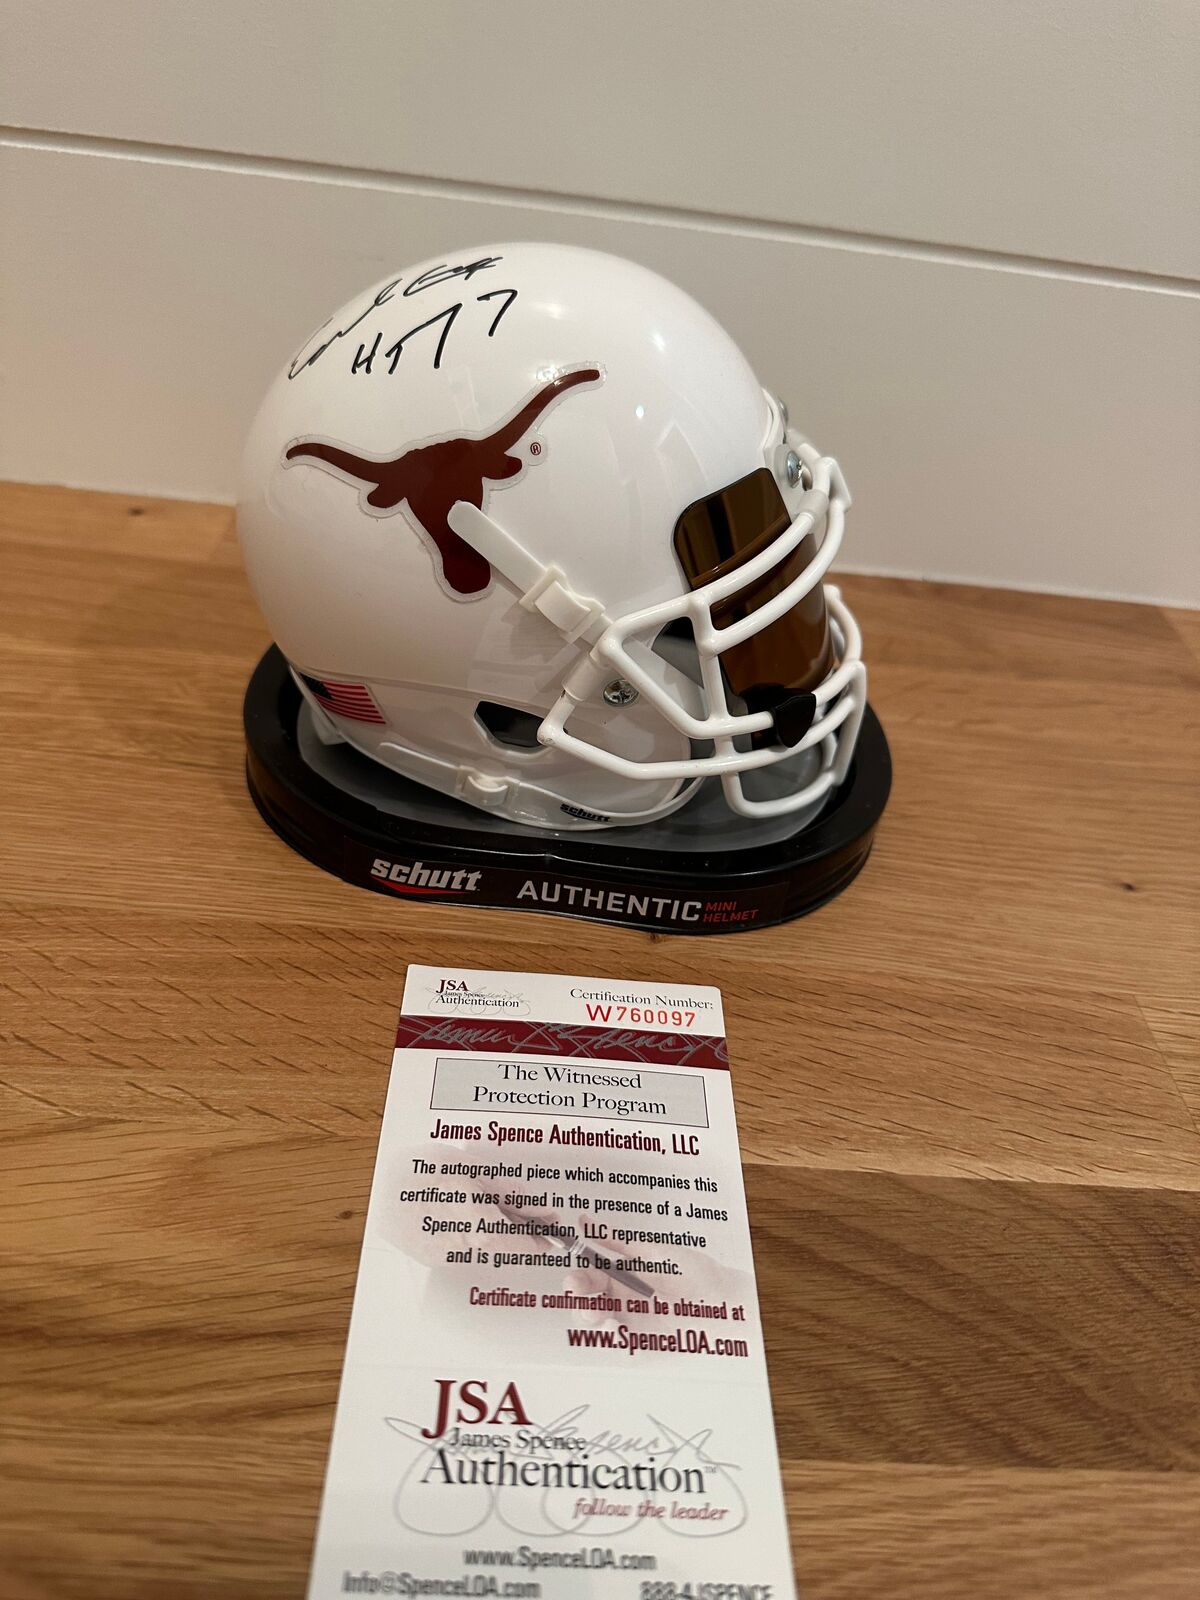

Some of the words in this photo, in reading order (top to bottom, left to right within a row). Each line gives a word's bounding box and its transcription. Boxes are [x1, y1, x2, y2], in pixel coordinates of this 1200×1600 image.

[561, 803, 610, 822] schutt
[370, 858, 482, 891] schutt
[517, 880, 702, 922] AUTHENTIC
[705, 901, 737, 912] MINI
[703, 909, 759, 922] HELMET
[436, 979, 469, 993] JSA
[570, 987, 651, 1006] Certification
[655, 996, 713, 1010] Number:
[436, 994, 519, 1008] Authentication
[586, 1003, 696, 1027] W760097
[498, 1064, 538, 1081] The
[544, 1066, 642, 1089] Witnessed
[473, 1086, 575, 1107] Protection
[582, 1092, 667, 1116] Program
[430, 1119, 481, 1141] James
[487, 1121, 543, 1146] Spence
[549, 1124, 666, 1155] Authentication,
[672, 1133, 700, 1156] LLC
[412, 1159, 436, 1175] The
[441, 1162, 523, 1182] autographed
[527, 1164, 560, 1182] piece
[565, 1166, 604, 1183] which
[608, 1171, 690, 1194] accompanies
[694, 1177, 718, 1193] this
[400, 1188, 467, 1205] certificate
[471, 1193, 500, 1207] was
[504, 1191, 547, 1213] signed
[552, 1194, 564, 1209] in
[569, 1195, 590, 1211] the
[594, 1199, 652, 1217] presence
[656, 1202, 670, 1216] of
[674, 1206, 682, 1217] a
[686, 1203, 728, 1223] James
[421, 1217, 471, 1237] Spence
[476, 1219, 579, 1241] Authentication,
[584, 1224, 608, 1241] LLC
[612, 1229, 707, 1249] representative
[446, 1248, 472, 1264] and
[477, 1248, 489, 1264] is
[494, 1252, 571, 1270] guaranteed
[576, 1253, 590, 1269] to
[595, 1254, 612, 1271] be
[616, 1258, 683, 1276] authentic.
[469, 1286, 537, 1309] Certificate
[541, 1291, 622, 1313] confirmation
[626, 1298, 649, 1314] can
[654, 1296, 670, 1316] be
[674, 1300, 727, 1320] obtained
[731, 1304, 745, 1322] at
[568, 1324, 749, 1358] www.SpenceLOA.com
[421, 1379, 533, 1438] JSA
[451, 1427, 512, 1448] James
[516, 1428, 586, 1453] Spence
[421, 1448, 706, 1493] Authentication
[573, 1498, 631, 1519] follow
[637, 1499, 664, 1518] the
[670, 1503, 729, 1521] leader
[464, 1546, 656, 1572] www.SpenceLOA.com
